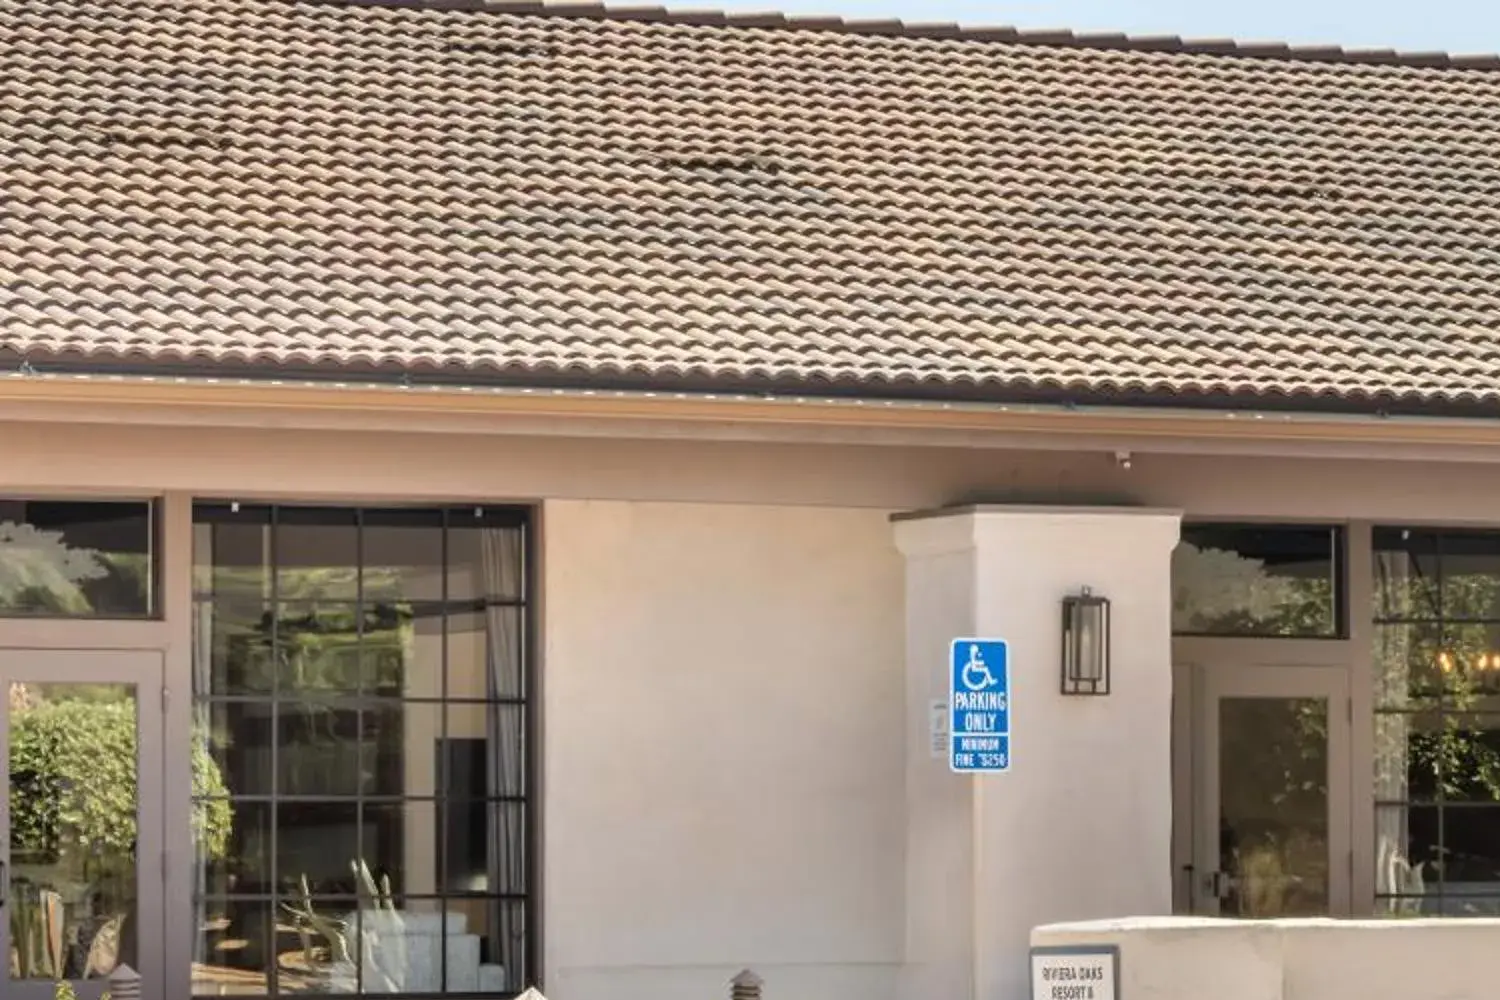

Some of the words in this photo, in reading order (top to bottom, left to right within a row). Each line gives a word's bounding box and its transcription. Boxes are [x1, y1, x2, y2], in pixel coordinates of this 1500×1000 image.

[955, 691, 1006, 710] PARKING
[965, 712, 996, 731] ONLY
[961, 737, 1000, 751] MINIMUM
[955, 753, 975, 767] FINE
[1042, 967, 1076, 981] RIVIERA
[1079, 967, 1103, 981] OAKS
[1051, 986, 1085, 1000] RESORT
[1088, 986, 1094, 1000] &
